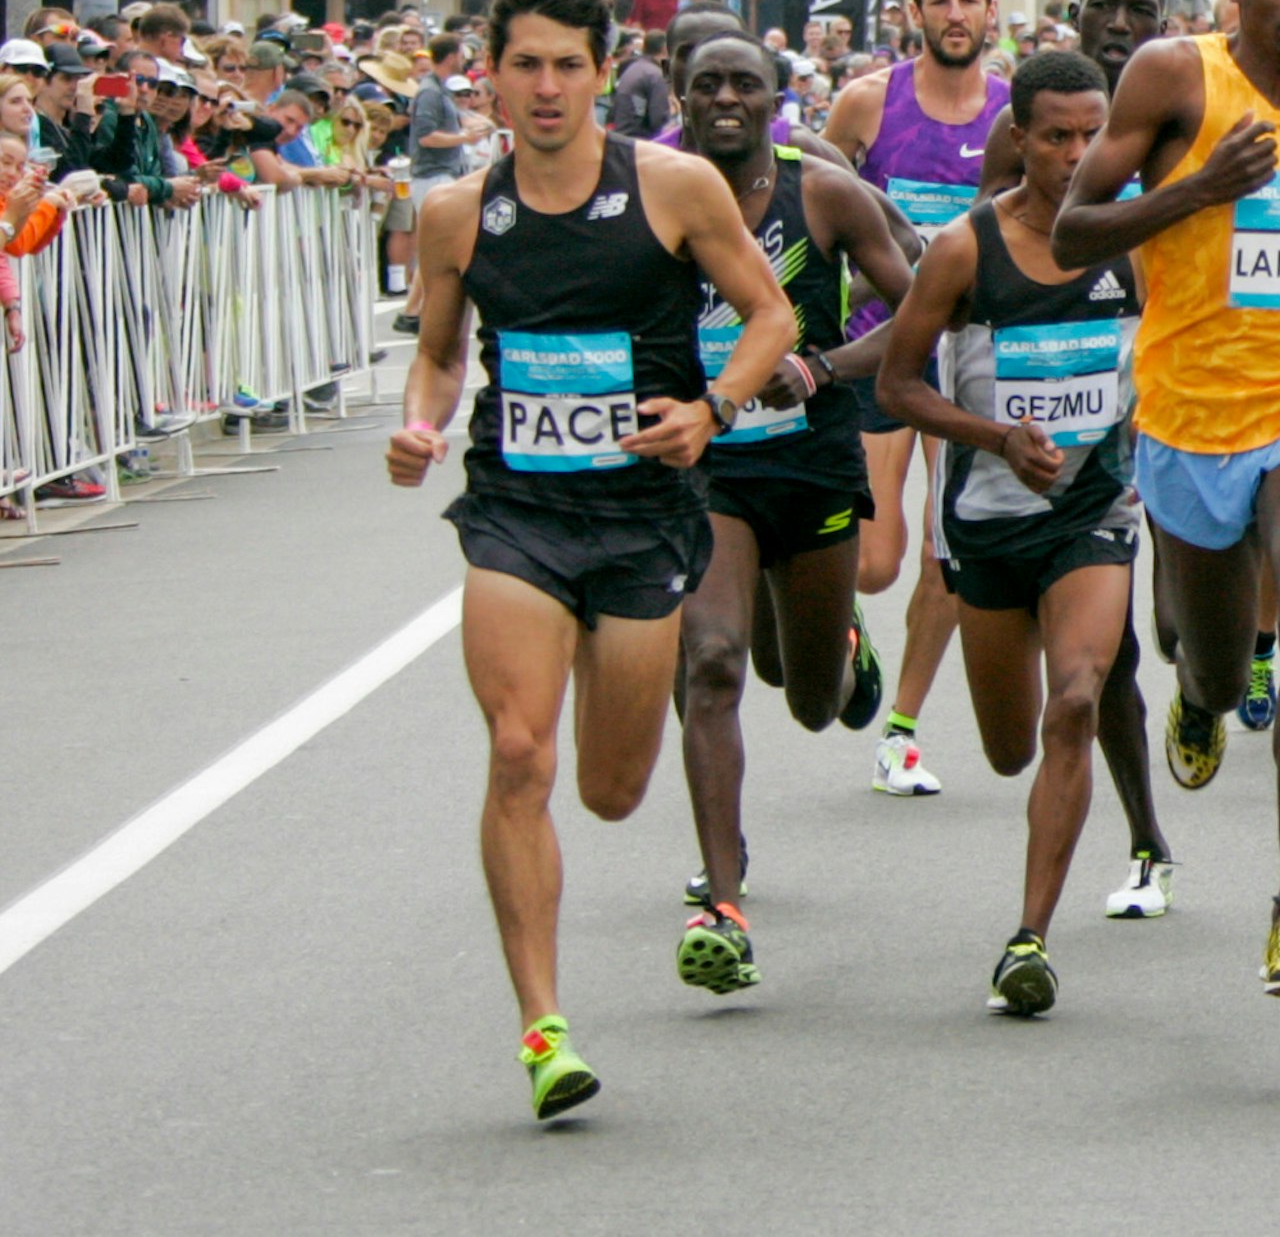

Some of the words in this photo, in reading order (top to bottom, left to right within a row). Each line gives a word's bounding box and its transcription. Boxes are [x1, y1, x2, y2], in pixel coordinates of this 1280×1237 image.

[504, 348, 581, 364] CARLSBAD
[583, 348, 627, 365] 5000
[1000, 338, 1078, 353] CARLSBAD
[1080, 334, 1117, 349] 5000
[1006, 388, 1104, 421] GEZMU
[508, 401, 634, 446] PACE
